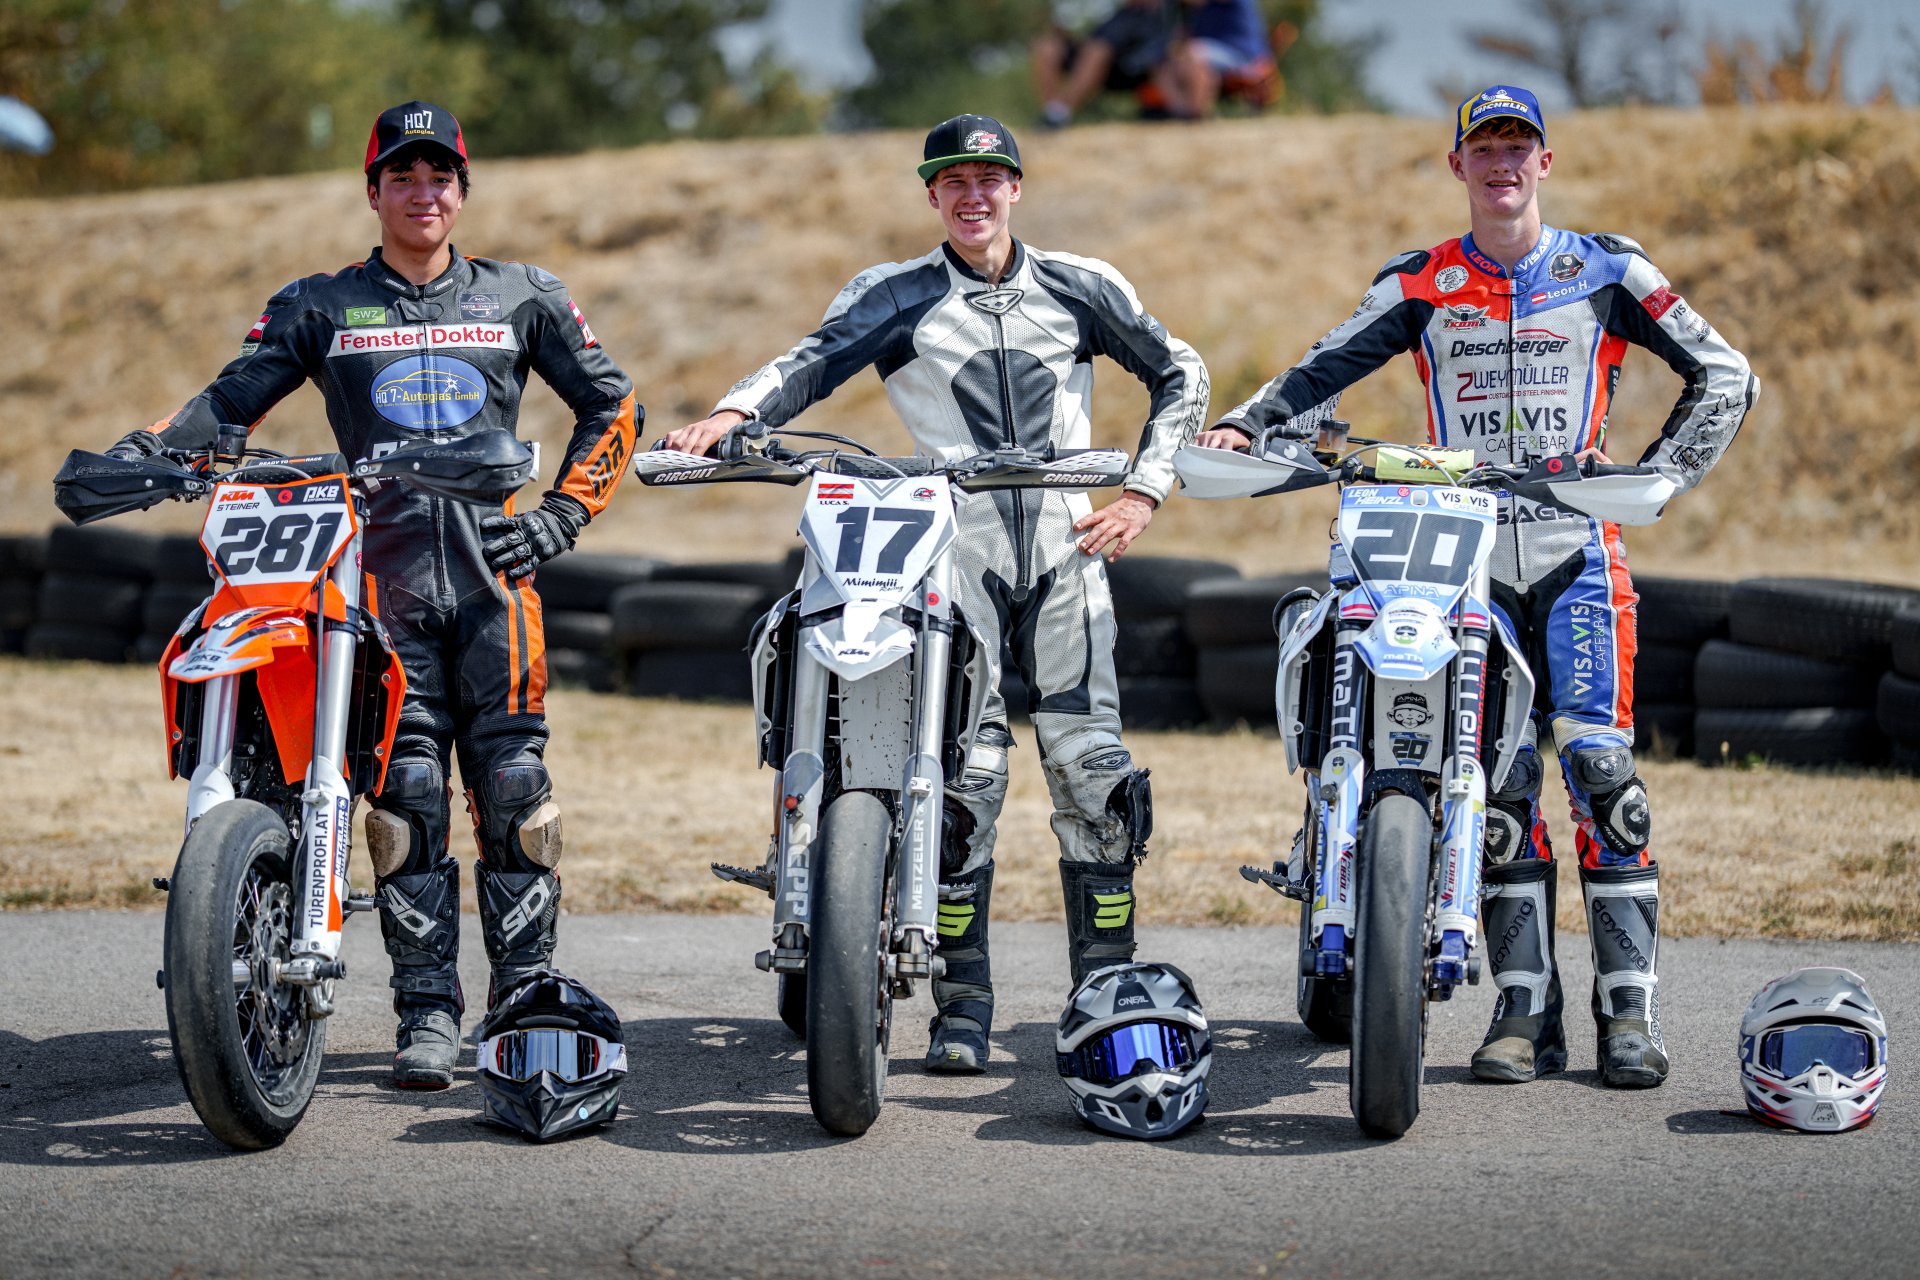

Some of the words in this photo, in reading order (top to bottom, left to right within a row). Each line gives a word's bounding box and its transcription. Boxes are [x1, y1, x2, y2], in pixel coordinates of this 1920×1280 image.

[404, 109, 432, 130] HQ7
[1472, 101, 1528, 117] MICHELIN
[1468, 251, 1501, 275] LEON
[1547, 285, 1577, 299] Leon
[1578, 279, 1591, 291] H.
[353, 310, 378, 320] SWZ
[340, 331, 425, 351] Fenster
[431, 326, 505, 344] Doktor
[1450, 338, 1569, 358] Deschberger
[1456, 363, 1569, 402] ZWEYMÜLLER
[375, 391, 388, 404] HQ
[455, 391, 480, 401] GmbH
[653, 467, 717, 484] CIRCUIT
[1042, 473, 1107, 484] CIRCUIT
[218, 490, 255, 502] KTM
[1348, 488, 1380, 498] LEON
[1354, 496, 1404, 505] HEINZL
[217, 502, 260, 511] STEINER
[215, 512, 344, 577] 281
[835, 506, 935, 574] 17
[1351, 511, 1484, 587] 20
[1593, 604, 1606, 671] CAFE&BAR
[1571, 605, 1593, 696] VISAVIS
[1392, 739, 1430, 760] 20
[334, 809, 345, 877] METZELER
[310, 811, 329, 928] TÜRENPROFI.AT
[785, 823, 812, 917] SEPP
[911, 820, 925, 910] METZELER
[1491, 900, 1534, 976] daytona
[1591, 899, 1650, 972] daytona
